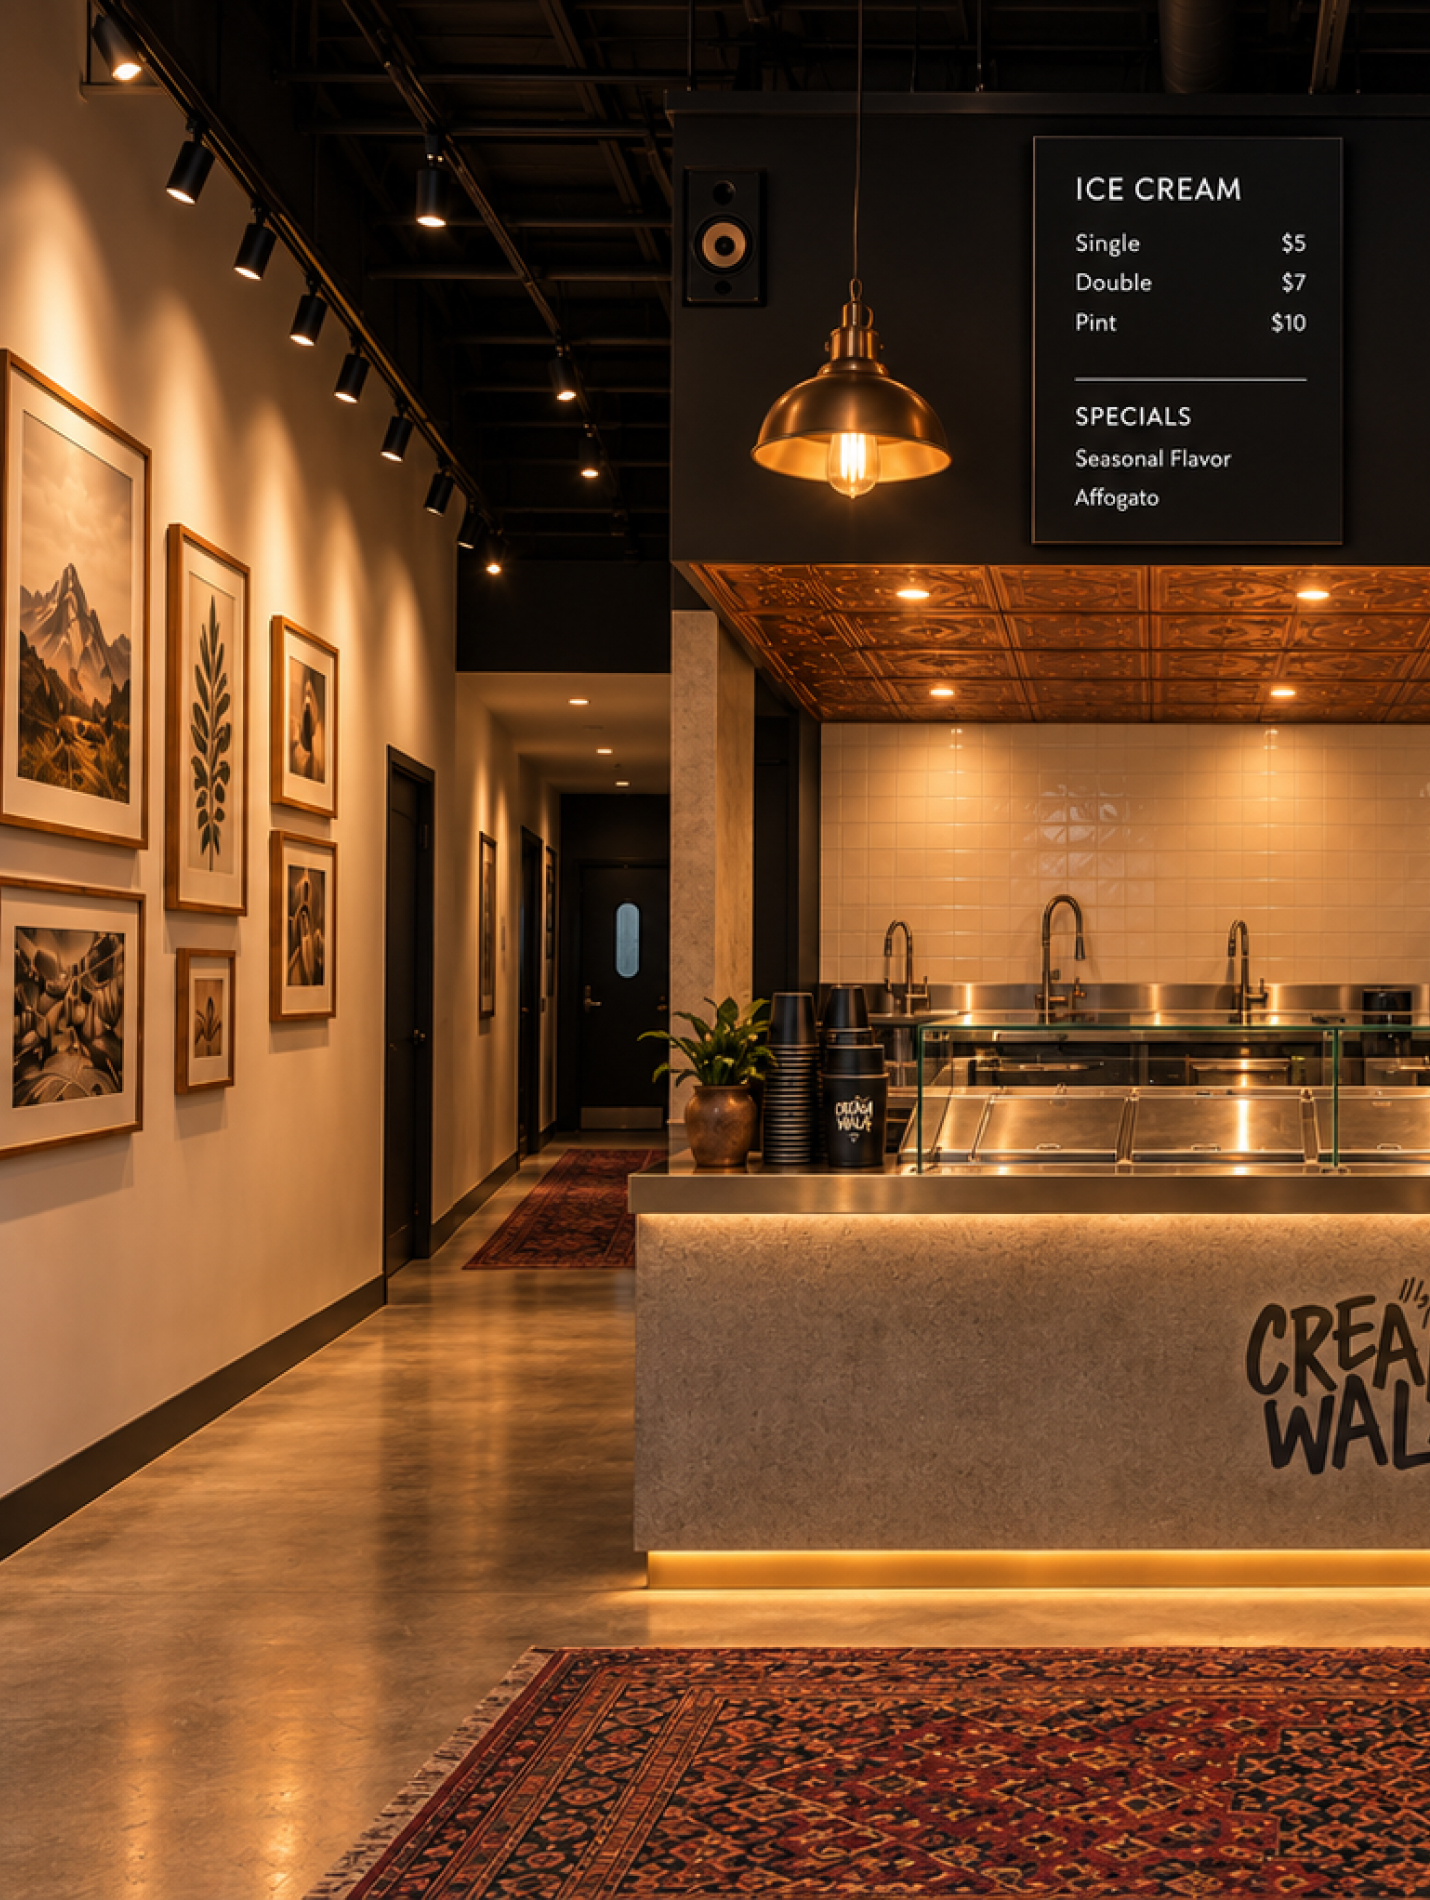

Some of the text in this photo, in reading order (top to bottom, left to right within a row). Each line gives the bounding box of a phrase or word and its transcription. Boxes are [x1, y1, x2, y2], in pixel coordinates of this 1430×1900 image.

[1076, 176, 1241, 202] ICE CREAM
[1075, 231, 1307, 258] Single $5
[1076, 271, 1307, 293] Double $7
[1075, 311, 1307, 334] Pint $10
[1075, 406, 1192, 427] SPECIALS
[1075, 447, 1233, 468] Seasonal Flavor
[1073, 486, 1160, 512] Affogato
